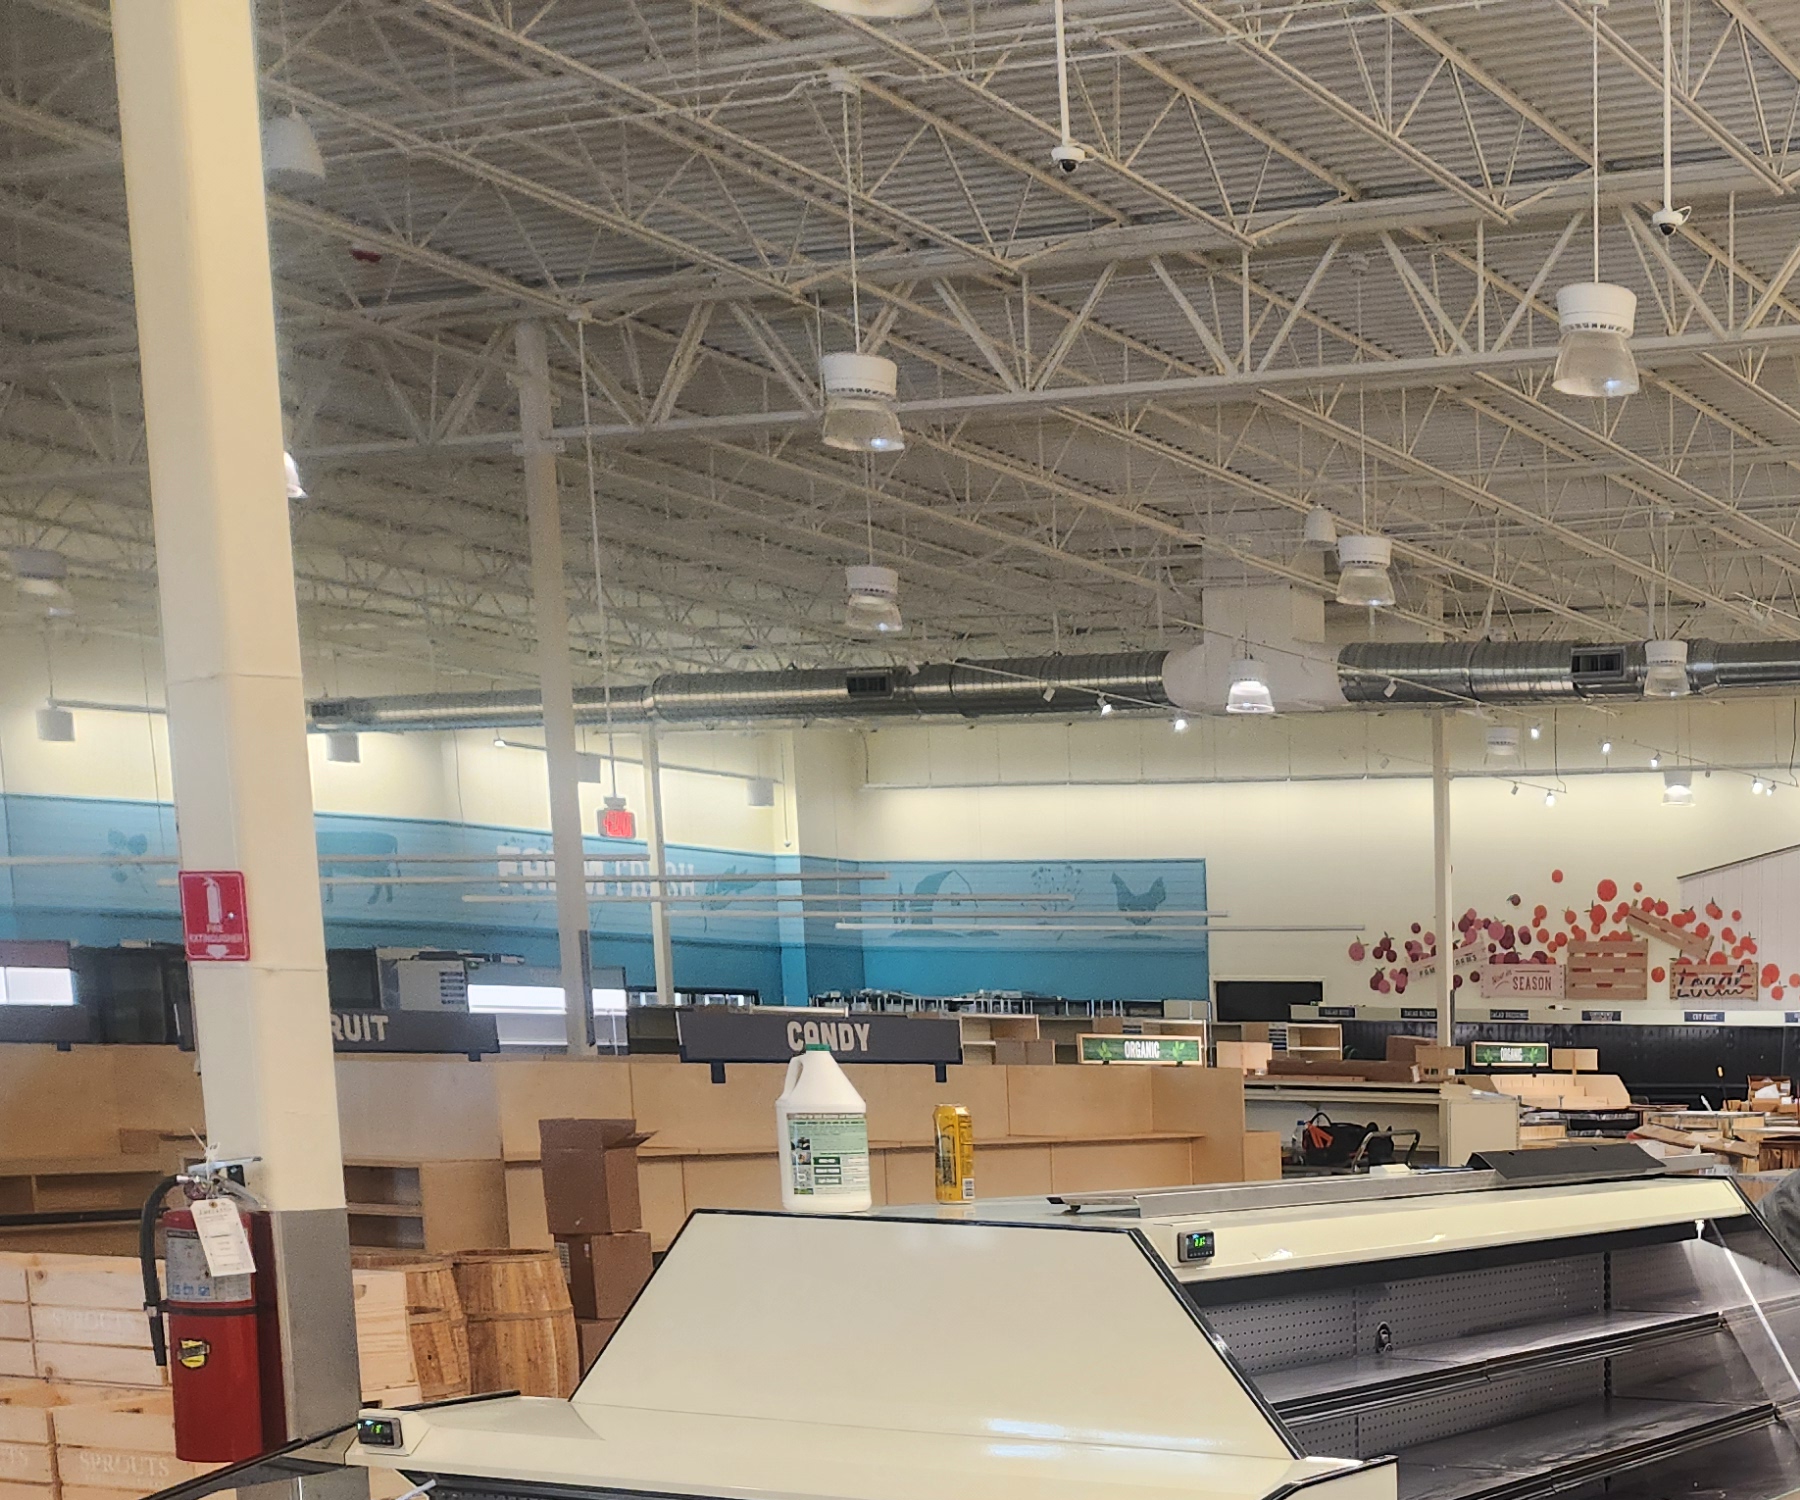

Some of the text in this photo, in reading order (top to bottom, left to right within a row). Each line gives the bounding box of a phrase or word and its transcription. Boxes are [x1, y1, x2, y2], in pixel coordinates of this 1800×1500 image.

[1512, 975, 1553, 992] SEASON
[329, 1013, 389, 1042] RUIT
[786, 1020, 870, 1052] CANDY
[1123, 1040, 1161, 1060] ORGANIC
[79, 1450, 170, 1478] SPROUTS
